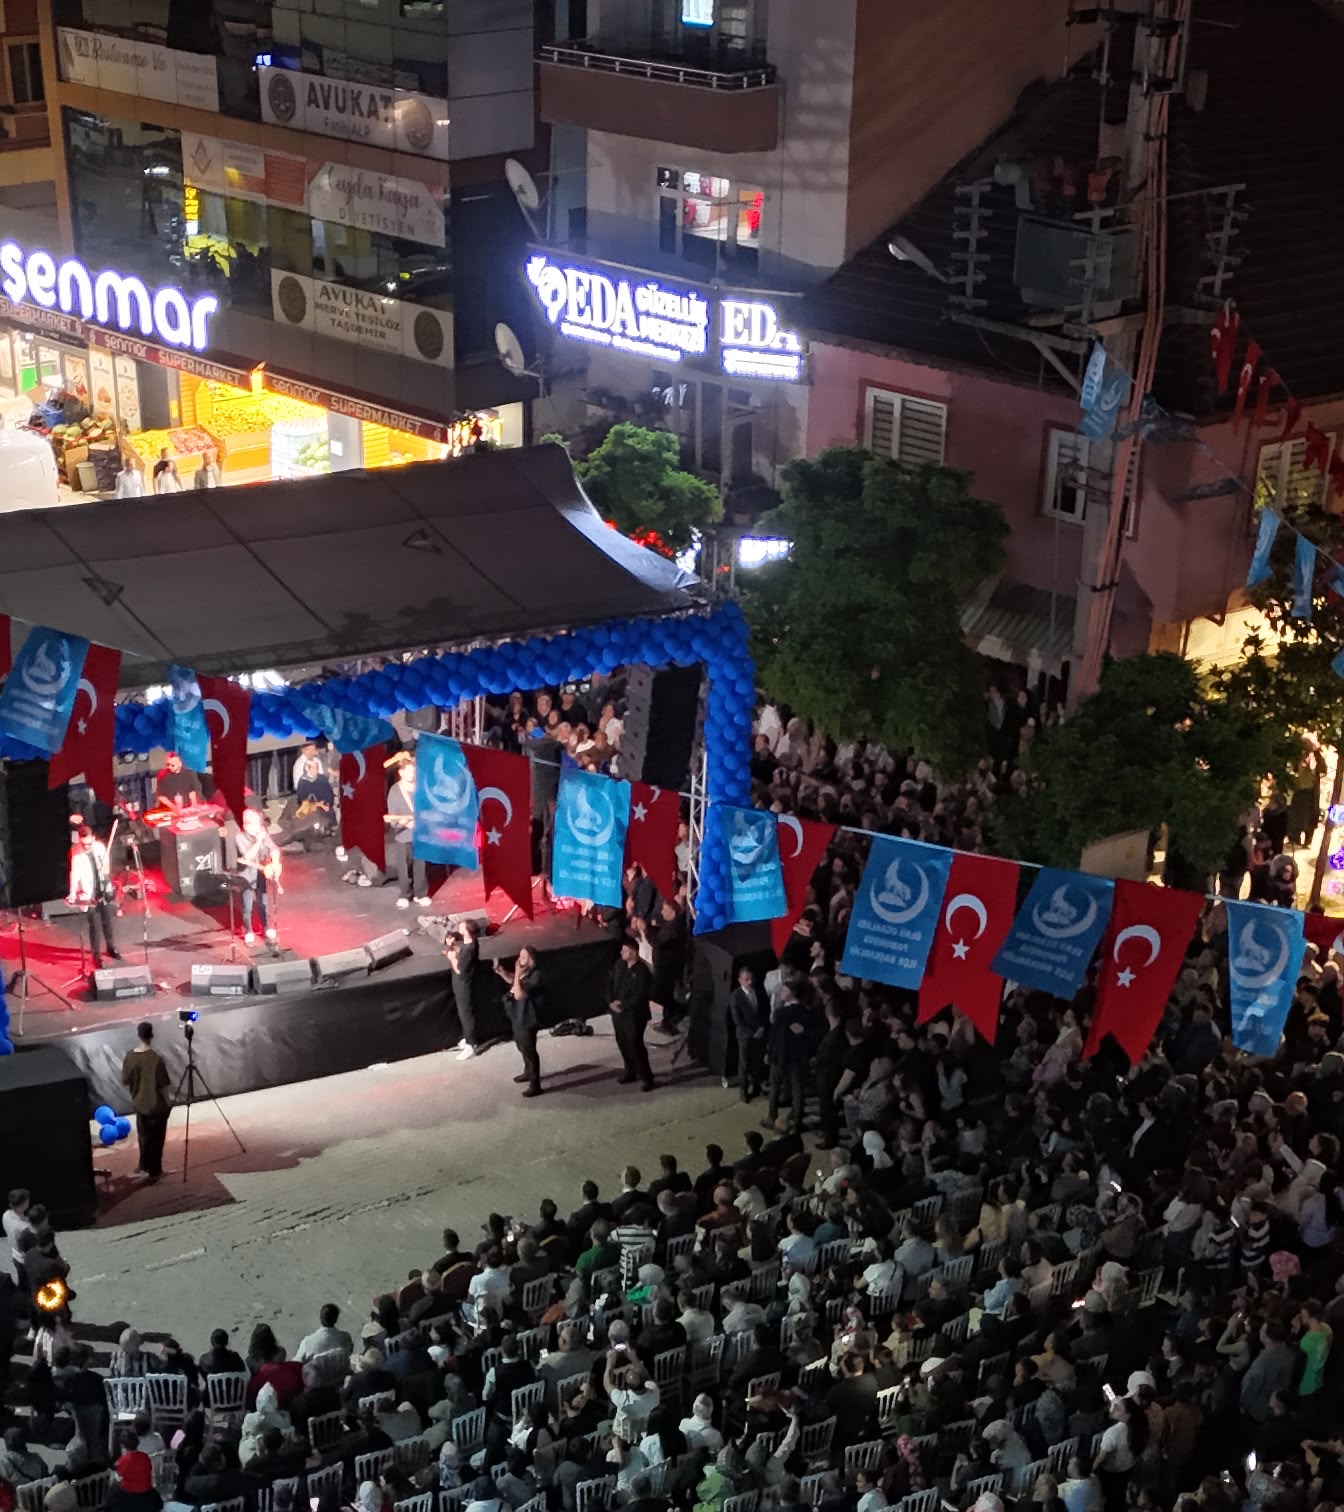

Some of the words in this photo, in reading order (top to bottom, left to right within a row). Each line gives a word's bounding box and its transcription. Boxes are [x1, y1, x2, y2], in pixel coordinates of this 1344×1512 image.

[307, 82, 393, 122] AVUKAT
[2, 299, 74, 331] SUPERMARKET
[320, 285, 387, 314] AVUKAT
[564, 268, 640, 337] EDA
[159, 350, 241, 385] SUPERMARKET
[331, 397, 424, 434] SUPERMARKET
